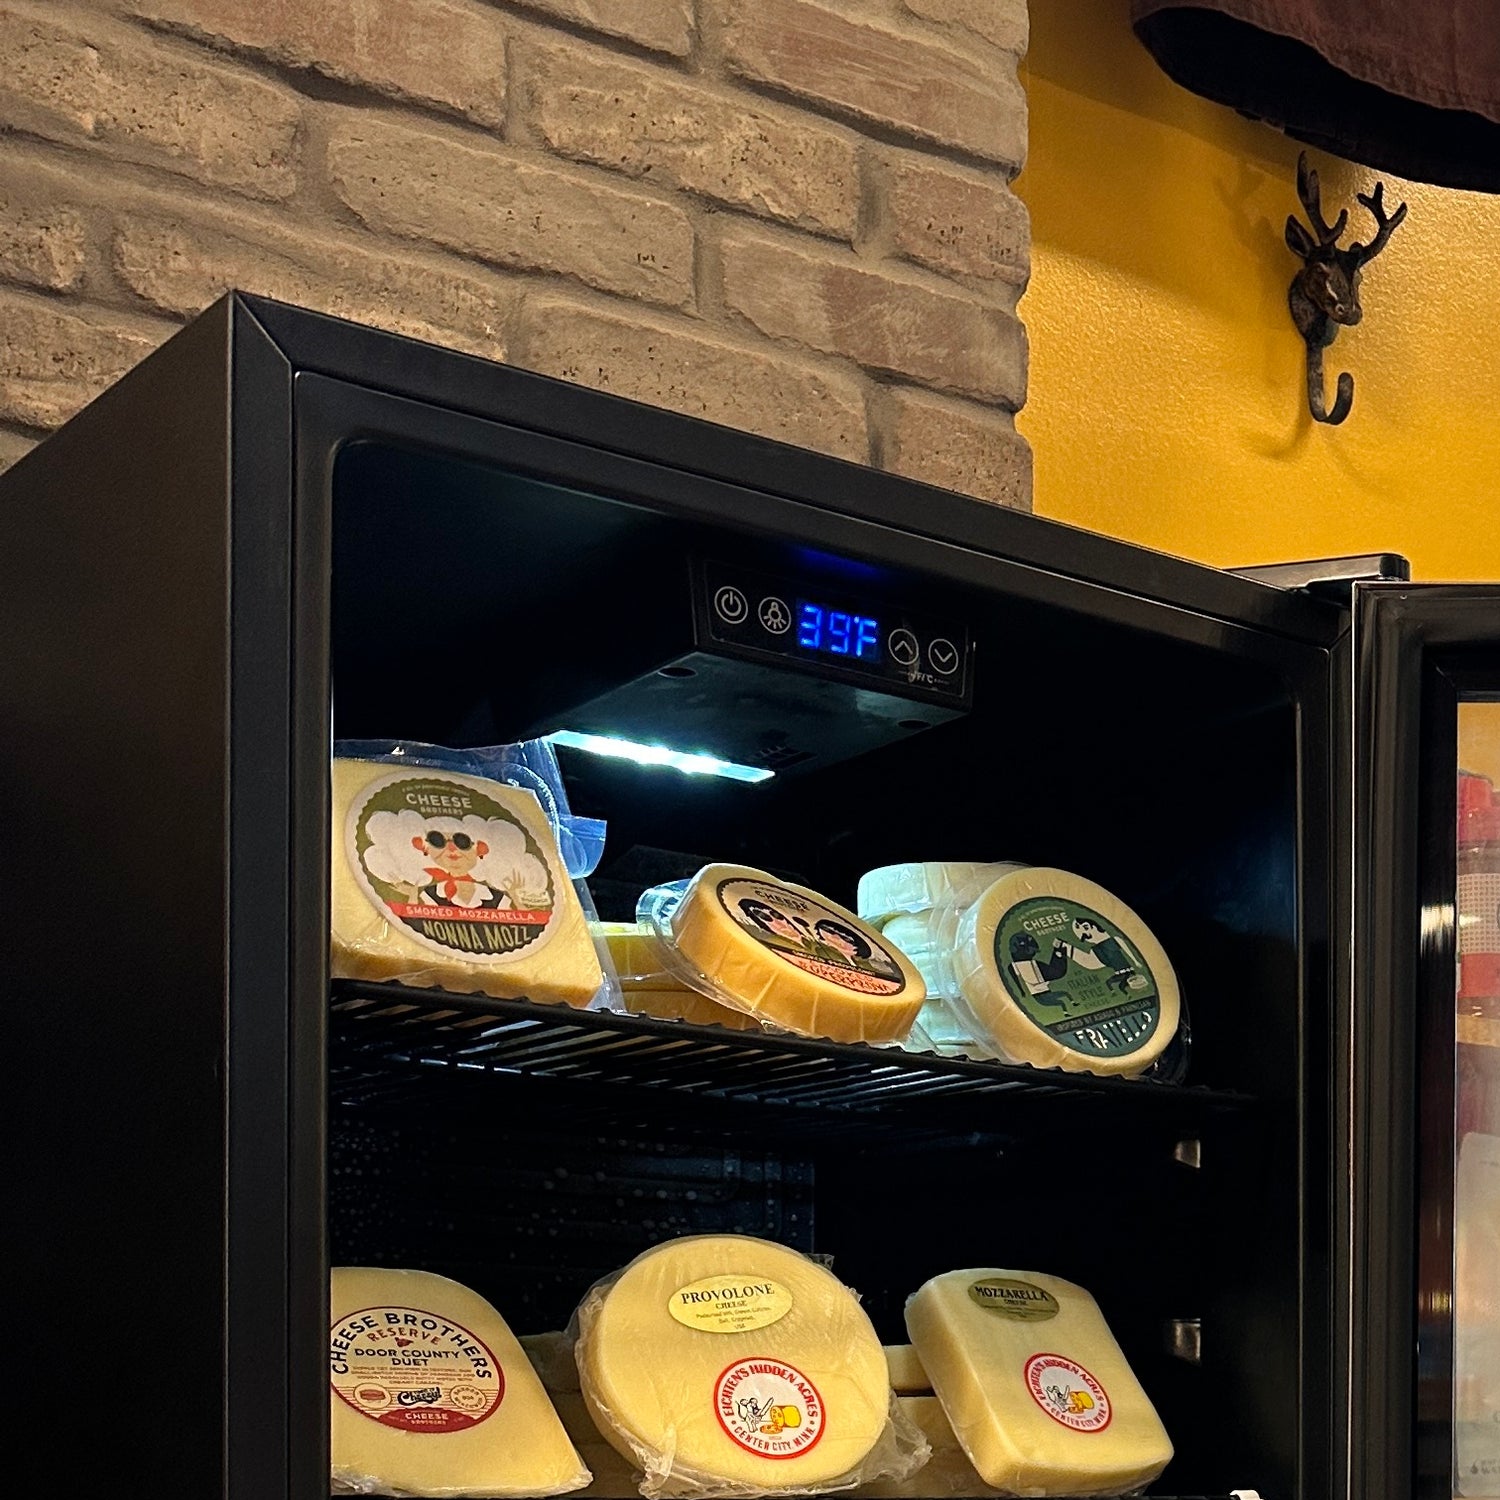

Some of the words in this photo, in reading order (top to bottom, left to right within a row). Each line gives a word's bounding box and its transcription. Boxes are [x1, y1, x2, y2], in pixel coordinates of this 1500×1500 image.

[406, 793, 473, 809] CHEESE
[406, 906, 453, 917] SMOKED
[458, 910, 535, 922] MOZZARELLA
[1023, 912, 1070, 932] CHEESE
[422, 920, 483, 950] NONNA
[484, 924, 531, 951] MOZZ
[1075, 1011, 1153, 1050] FRATELLO
[681, 1283, 775, 1305] PROVOLONE
[975, 1285, 1050, 1302] MOZZARELLA
[331, 1315, 378, 1374] CHEESE
[384, 1312, 492, 1379] BROTHERS
[367, 1327, 441, 1345] RESERVE
[355, 1348, 397, 1357] DOOR
[402, 1349, 460, 1360] COUNTY
[391, 1357, 429, 1367] DUET
[721, 1365, 750, 1417] EICHTEN'S
[748, 1364, 796, 1384] HIDDEN
[794, 1381, 819, 1418] ACRES
[405, 1413, 448, 1421] CHEESE
[734, 1425, 770, 1450] CENTER
